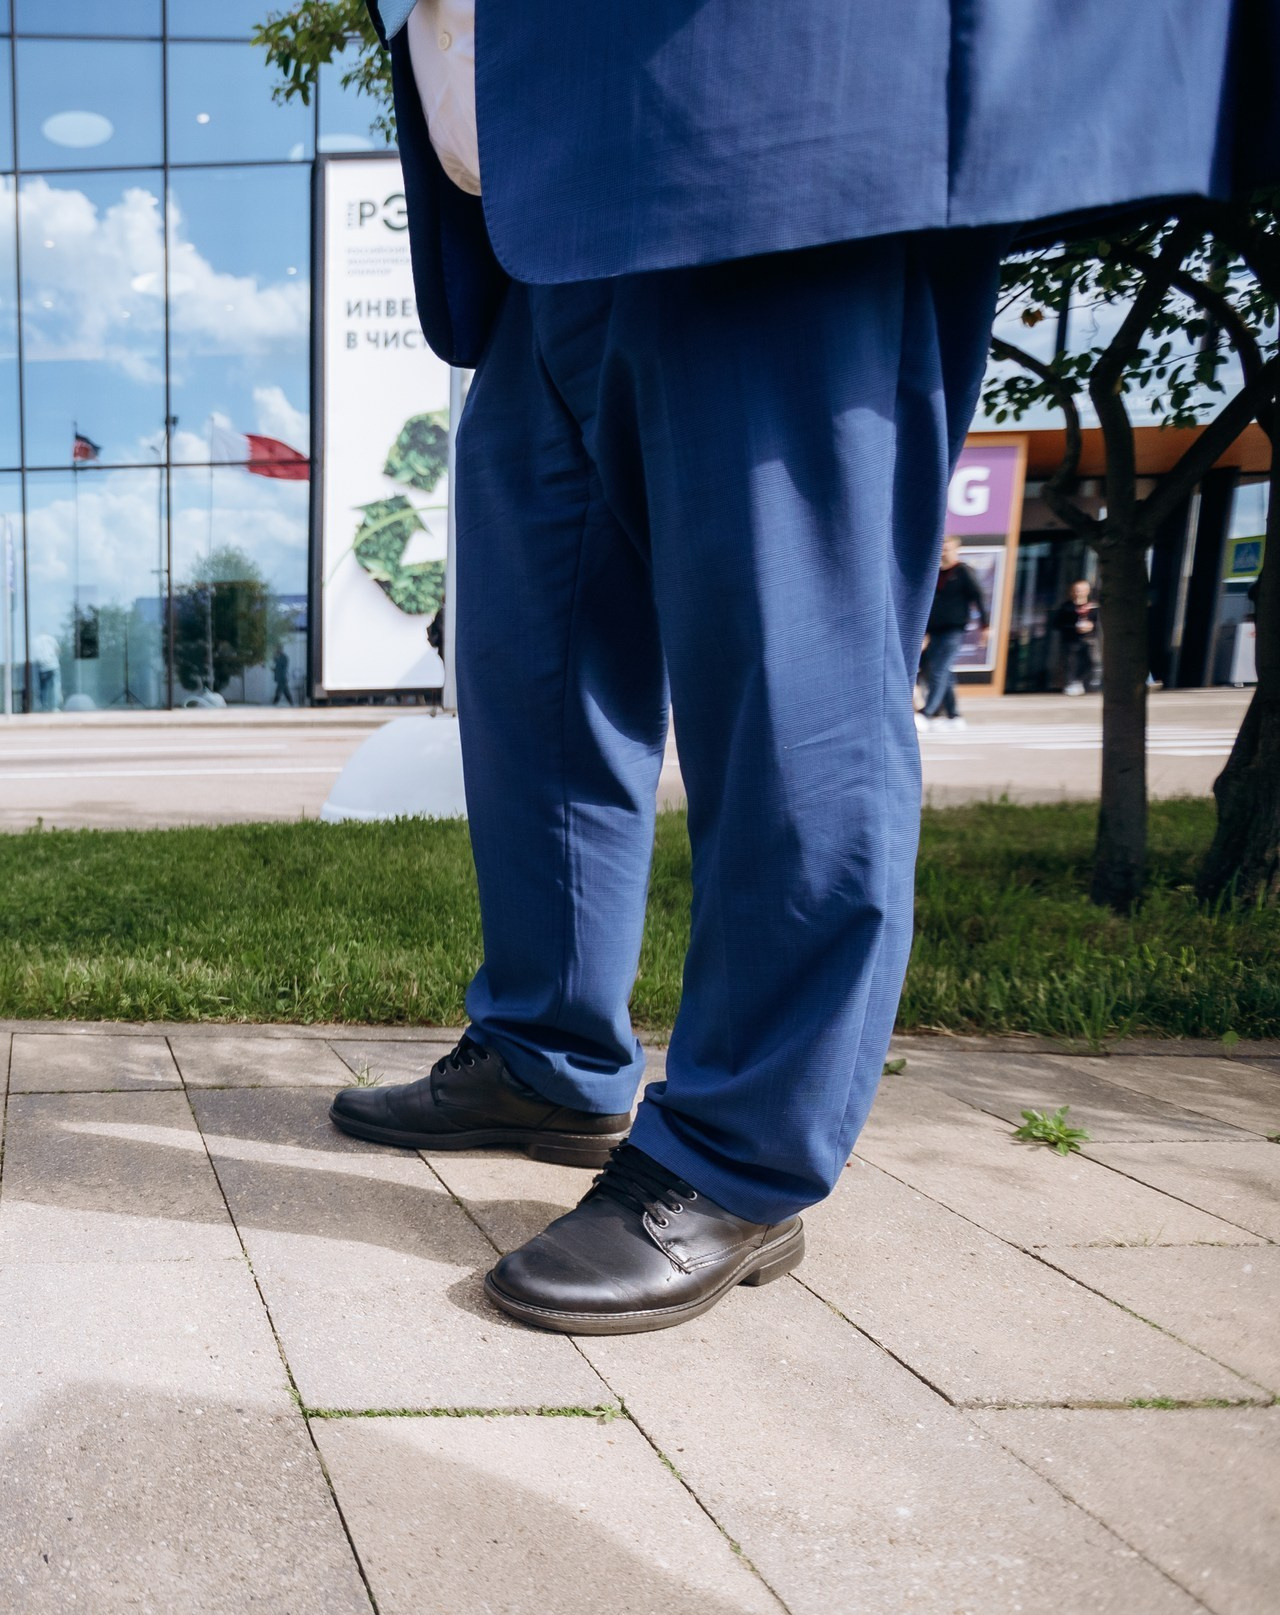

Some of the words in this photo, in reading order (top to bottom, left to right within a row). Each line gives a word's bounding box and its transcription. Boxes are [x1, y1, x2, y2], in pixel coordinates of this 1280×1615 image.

[358, 193, 408, 231] РЭ
[346, 299, 417, 318] ИНВЕ
[346, 331, 358, 349] В
[366, 330, 427, 349] ЧИСТ
[948, 466, 991, 516] G
